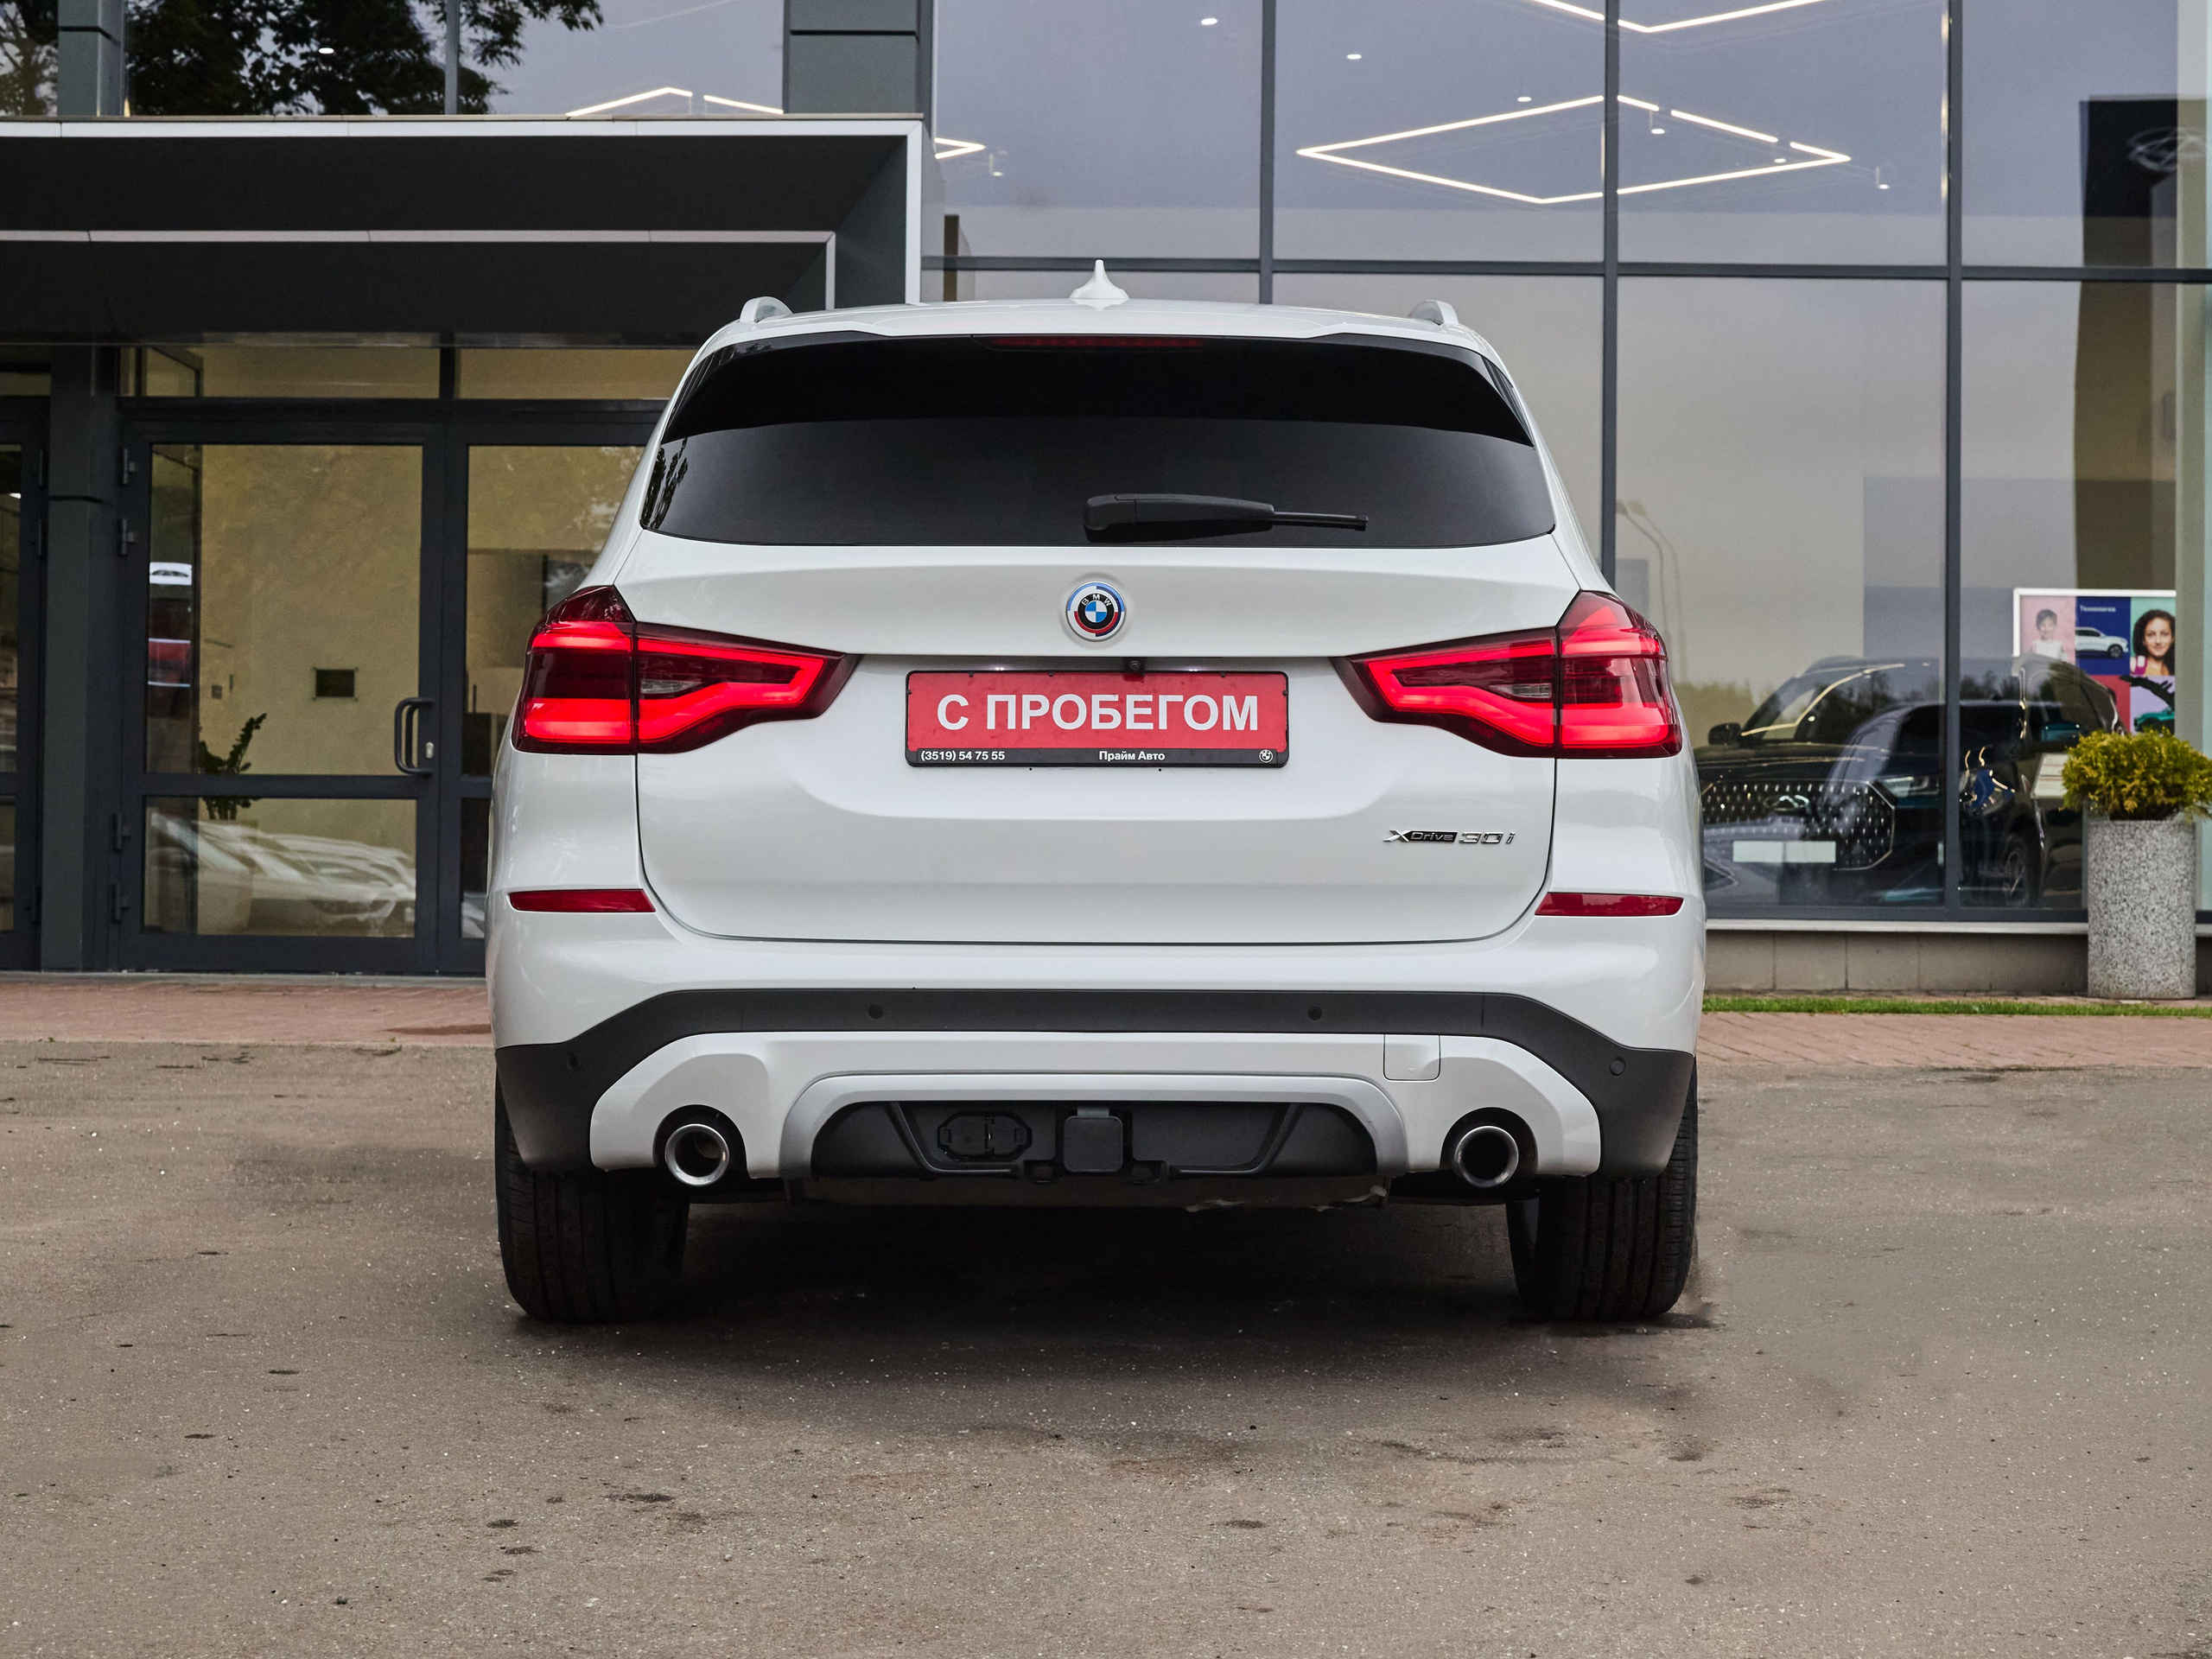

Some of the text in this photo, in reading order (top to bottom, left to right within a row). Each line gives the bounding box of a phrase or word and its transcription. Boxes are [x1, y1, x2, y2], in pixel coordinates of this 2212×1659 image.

[1082, 594, 1111, 606] BMW
[937, 693, 1259, 731] С ПРОБЕГОМ
[920, 749, 1006, 762] (3519) 54 75 55
[1098, 749, 1166, 762] Прайм Авто
